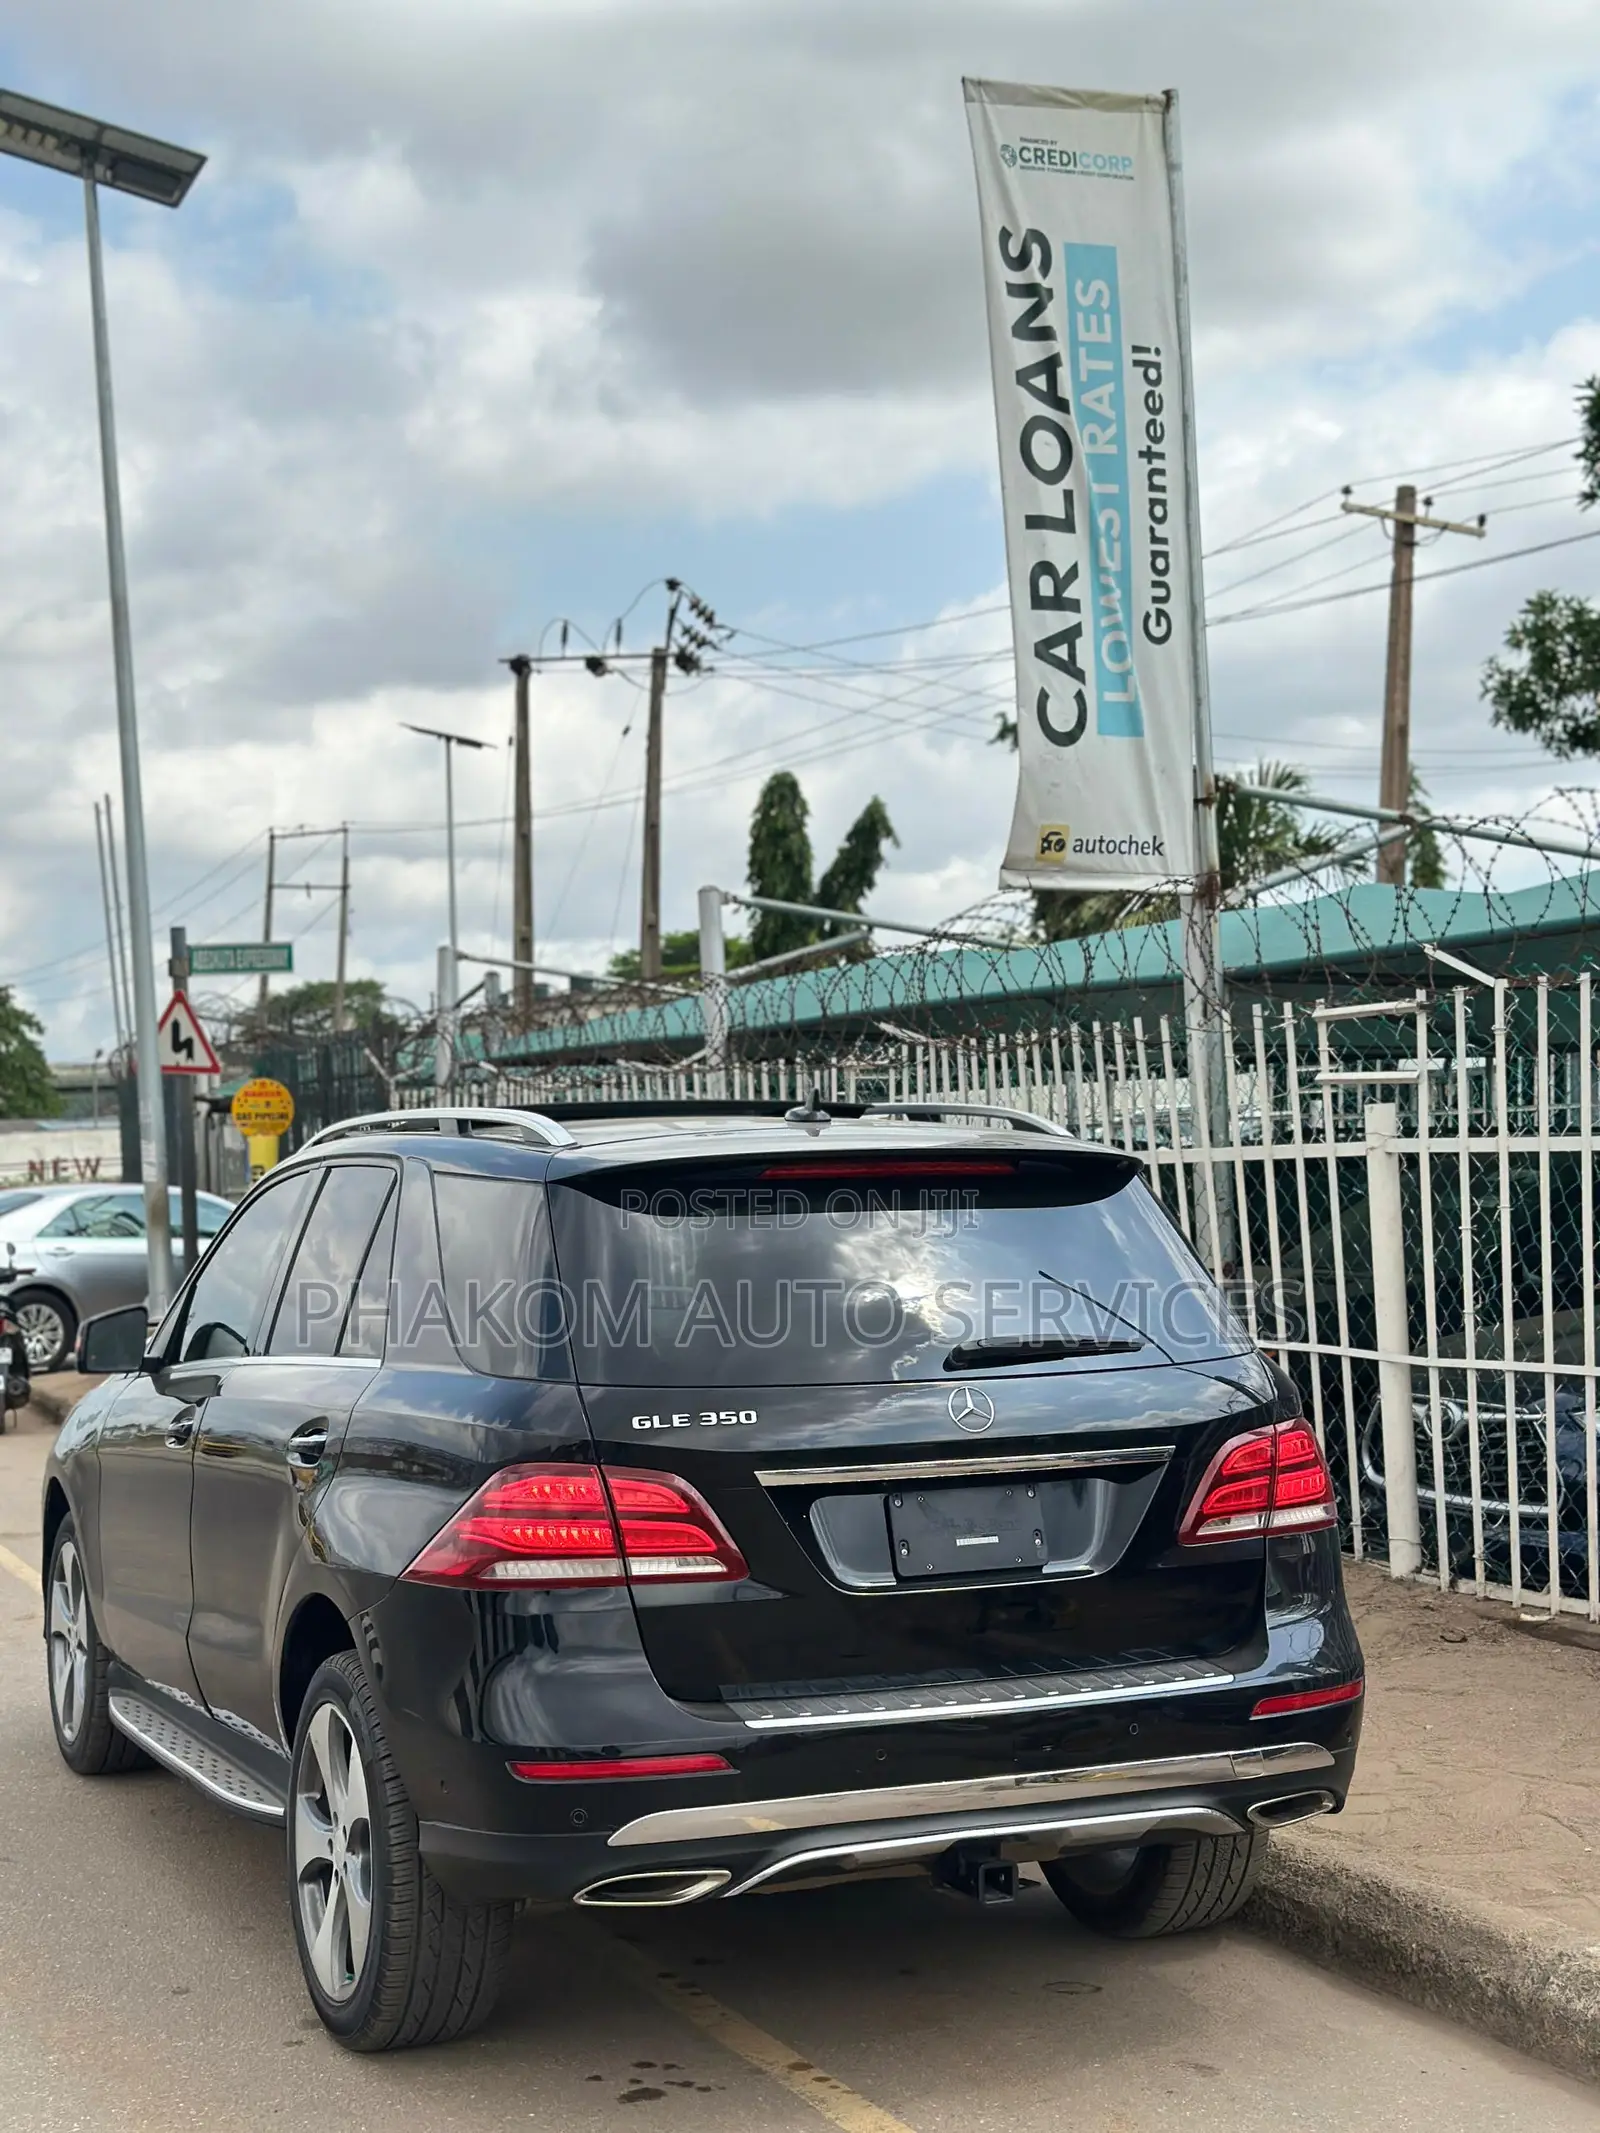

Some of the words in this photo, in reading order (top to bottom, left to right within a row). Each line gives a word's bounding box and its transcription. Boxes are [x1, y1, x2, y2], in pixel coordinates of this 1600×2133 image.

[1018, 146, 1132, 172] CREDICORP
[998, 225, 1077, 534] LOANS
[1075, 278, 1119, 455] RATES
[1131, 344, 1173, 646] Guaranteed!
[1028, 560, 1088, 748] CAR
[1092, 482, 1137, 703] LOWEST
[1072, 834, 1165, 857] autochek
[631, 1413, 692, 1430] GLE
[699, 1410, 758, 1426] 350
